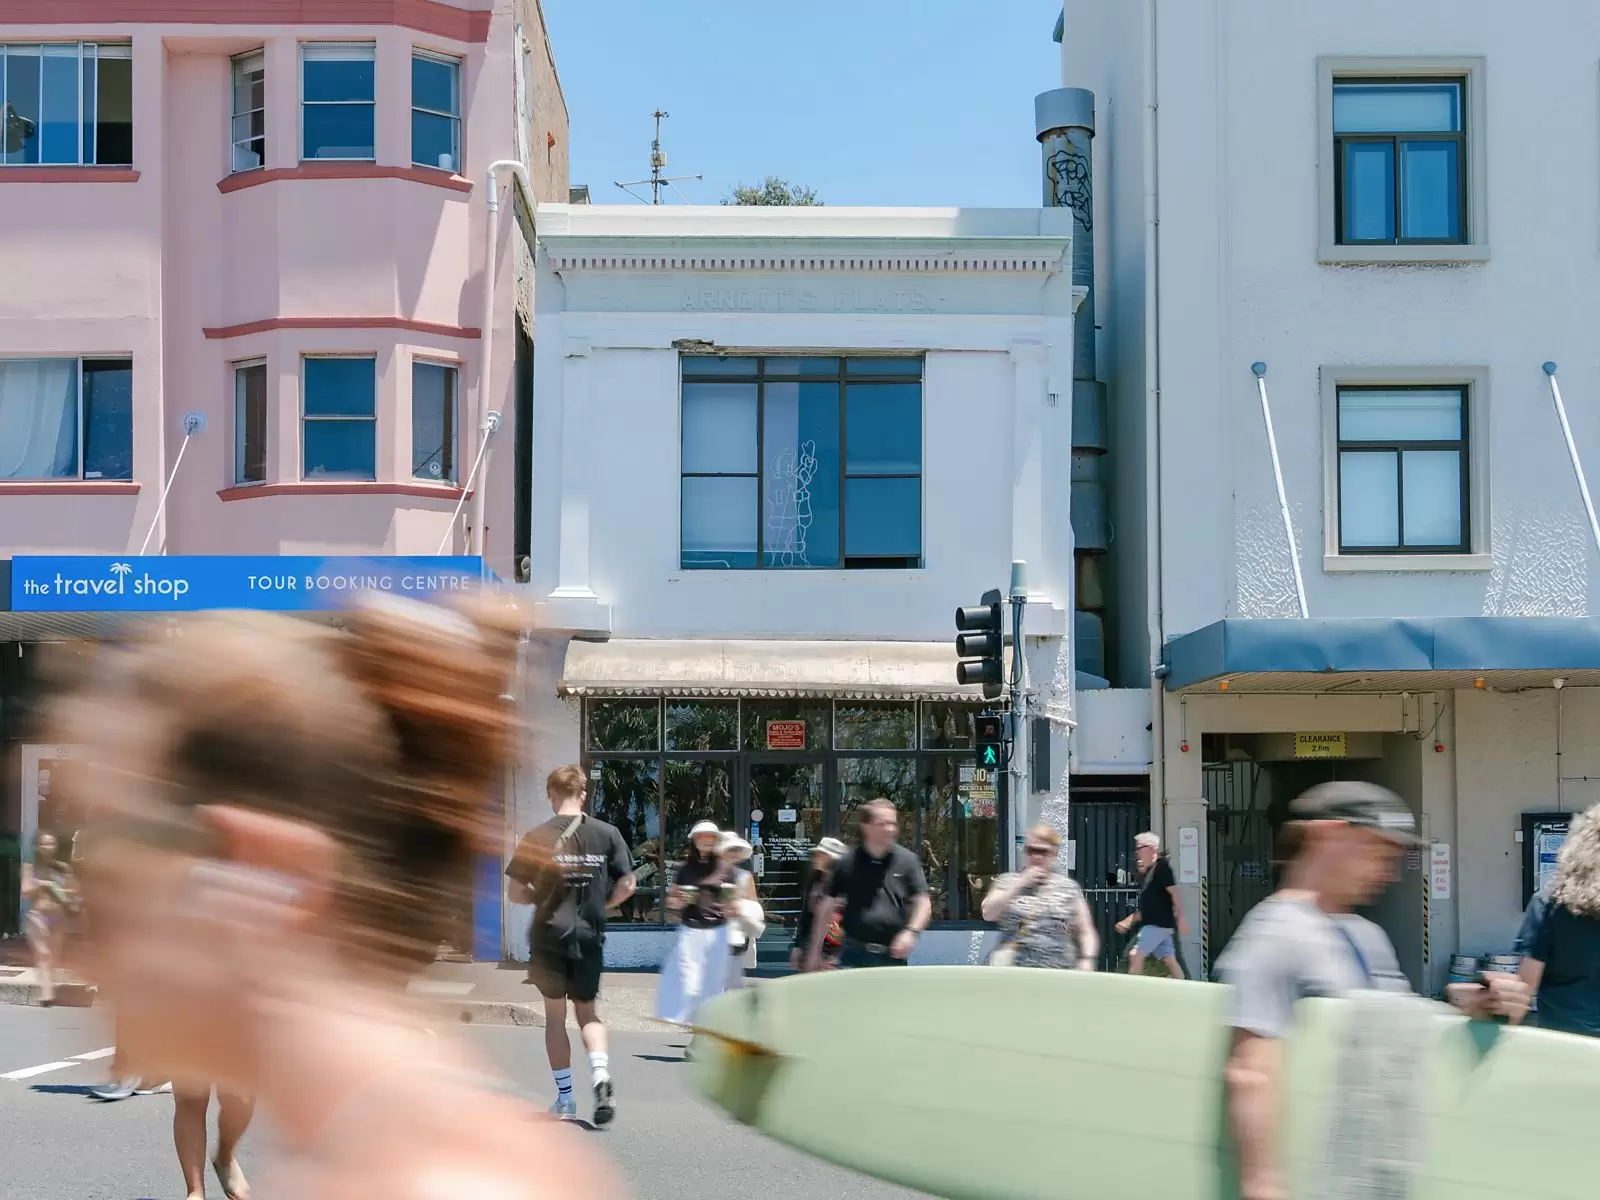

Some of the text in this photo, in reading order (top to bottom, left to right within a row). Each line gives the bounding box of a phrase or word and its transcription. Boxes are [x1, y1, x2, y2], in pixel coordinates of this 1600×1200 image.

[24, 563, 189, 601] the travel shop
[248, 576, 470, 590] TOUR BOOKING CENTRE
[1299, 735, 1342, 743] CLEARANCE
[1311, 744, 1330, 752] 2.6m
